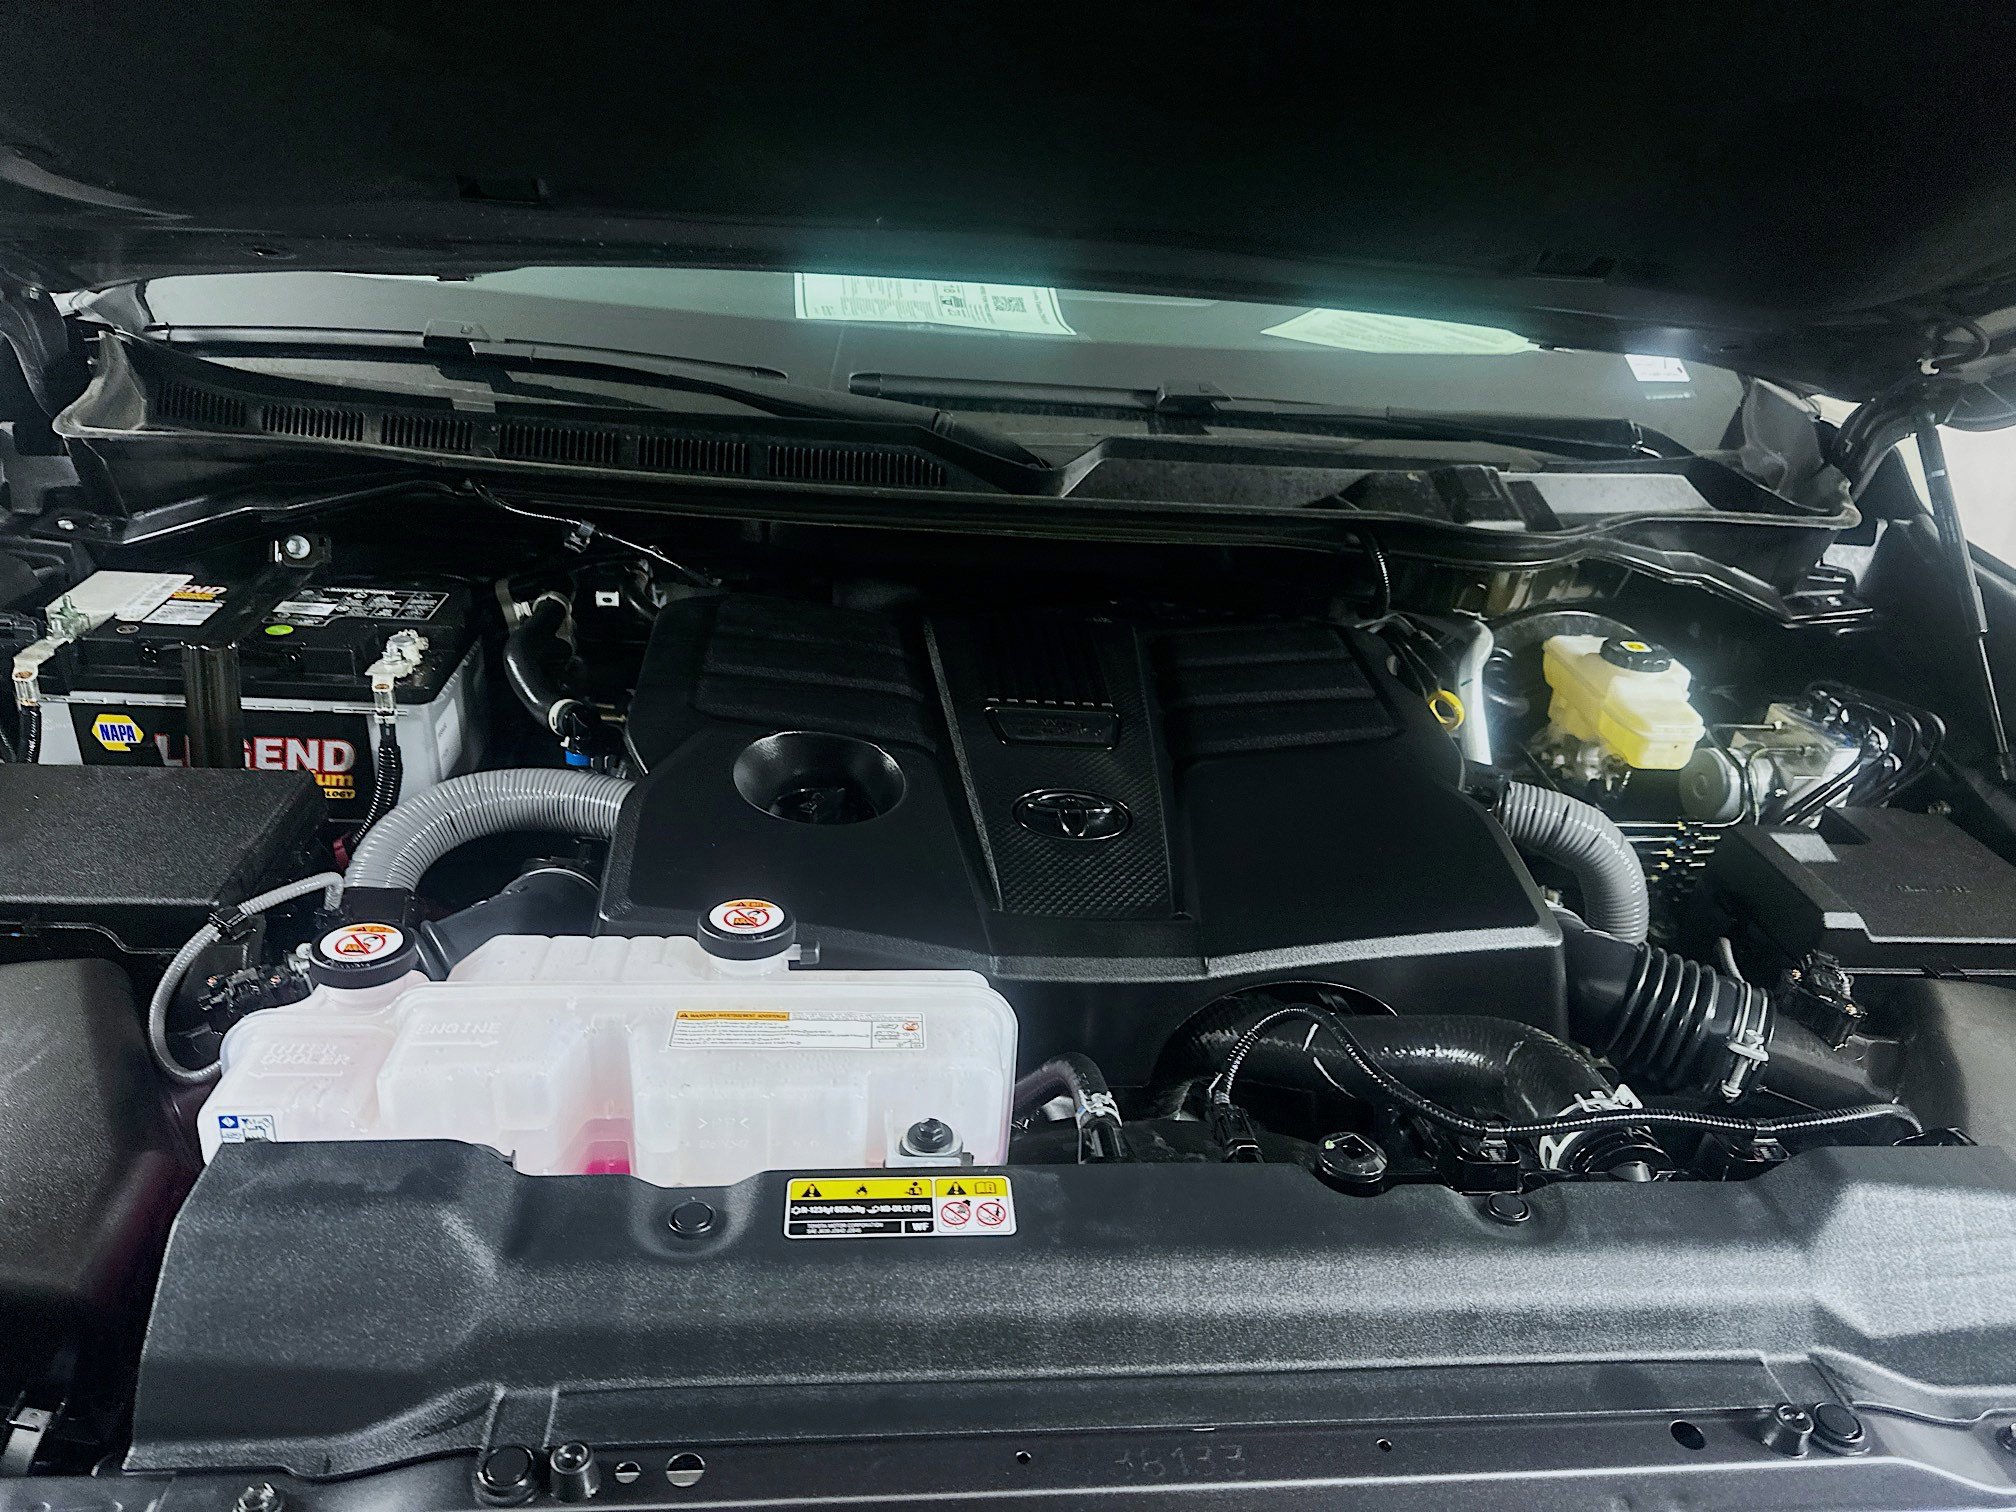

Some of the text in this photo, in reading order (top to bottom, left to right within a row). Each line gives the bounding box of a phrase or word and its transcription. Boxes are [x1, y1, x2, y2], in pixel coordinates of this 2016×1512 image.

[100, 724, 136, 742] NAPA
[154, 732, 356, 772] LEND
[417, 1022, 503, 1034] ENGINE
